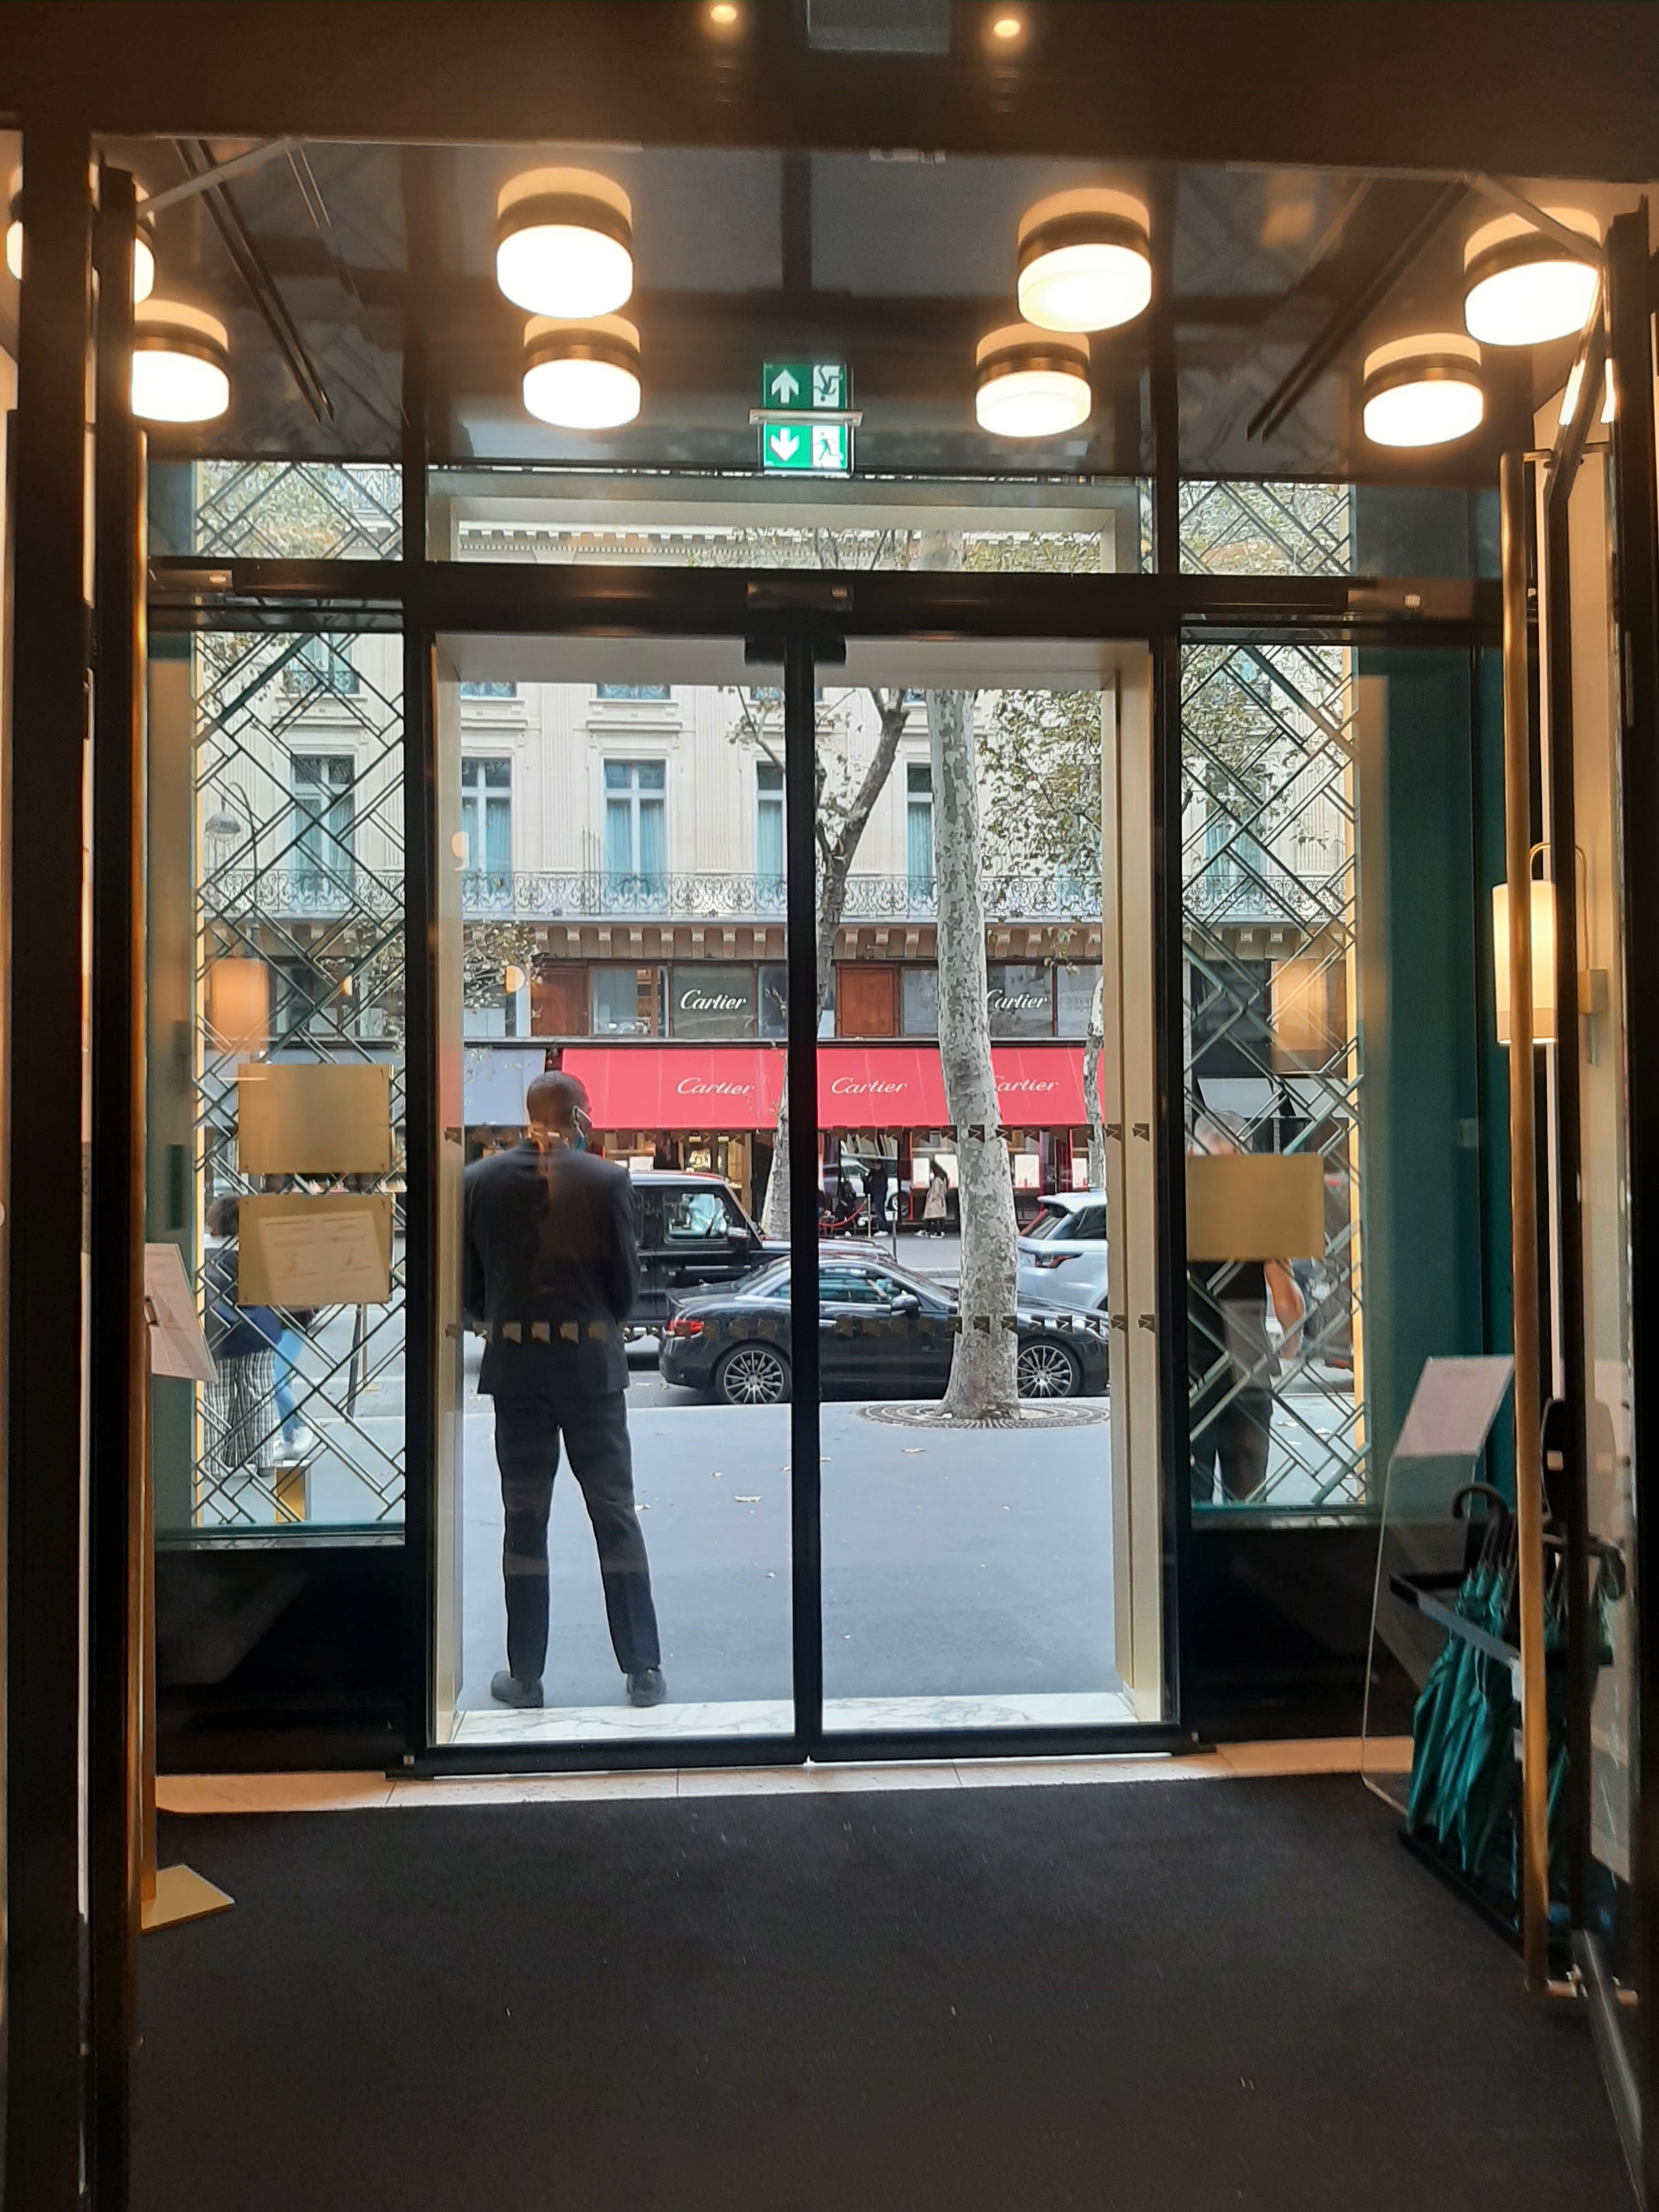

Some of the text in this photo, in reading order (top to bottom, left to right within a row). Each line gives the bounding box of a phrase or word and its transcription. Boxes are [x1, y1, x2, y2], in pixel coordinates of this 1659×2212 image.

[680, 989, 747, 1009] Cartier
[677, 1077, 755, 1094] Cartier
[831, 1076, 908, 1094] Cartier
[995, 1075, 1059, 1092] artier
